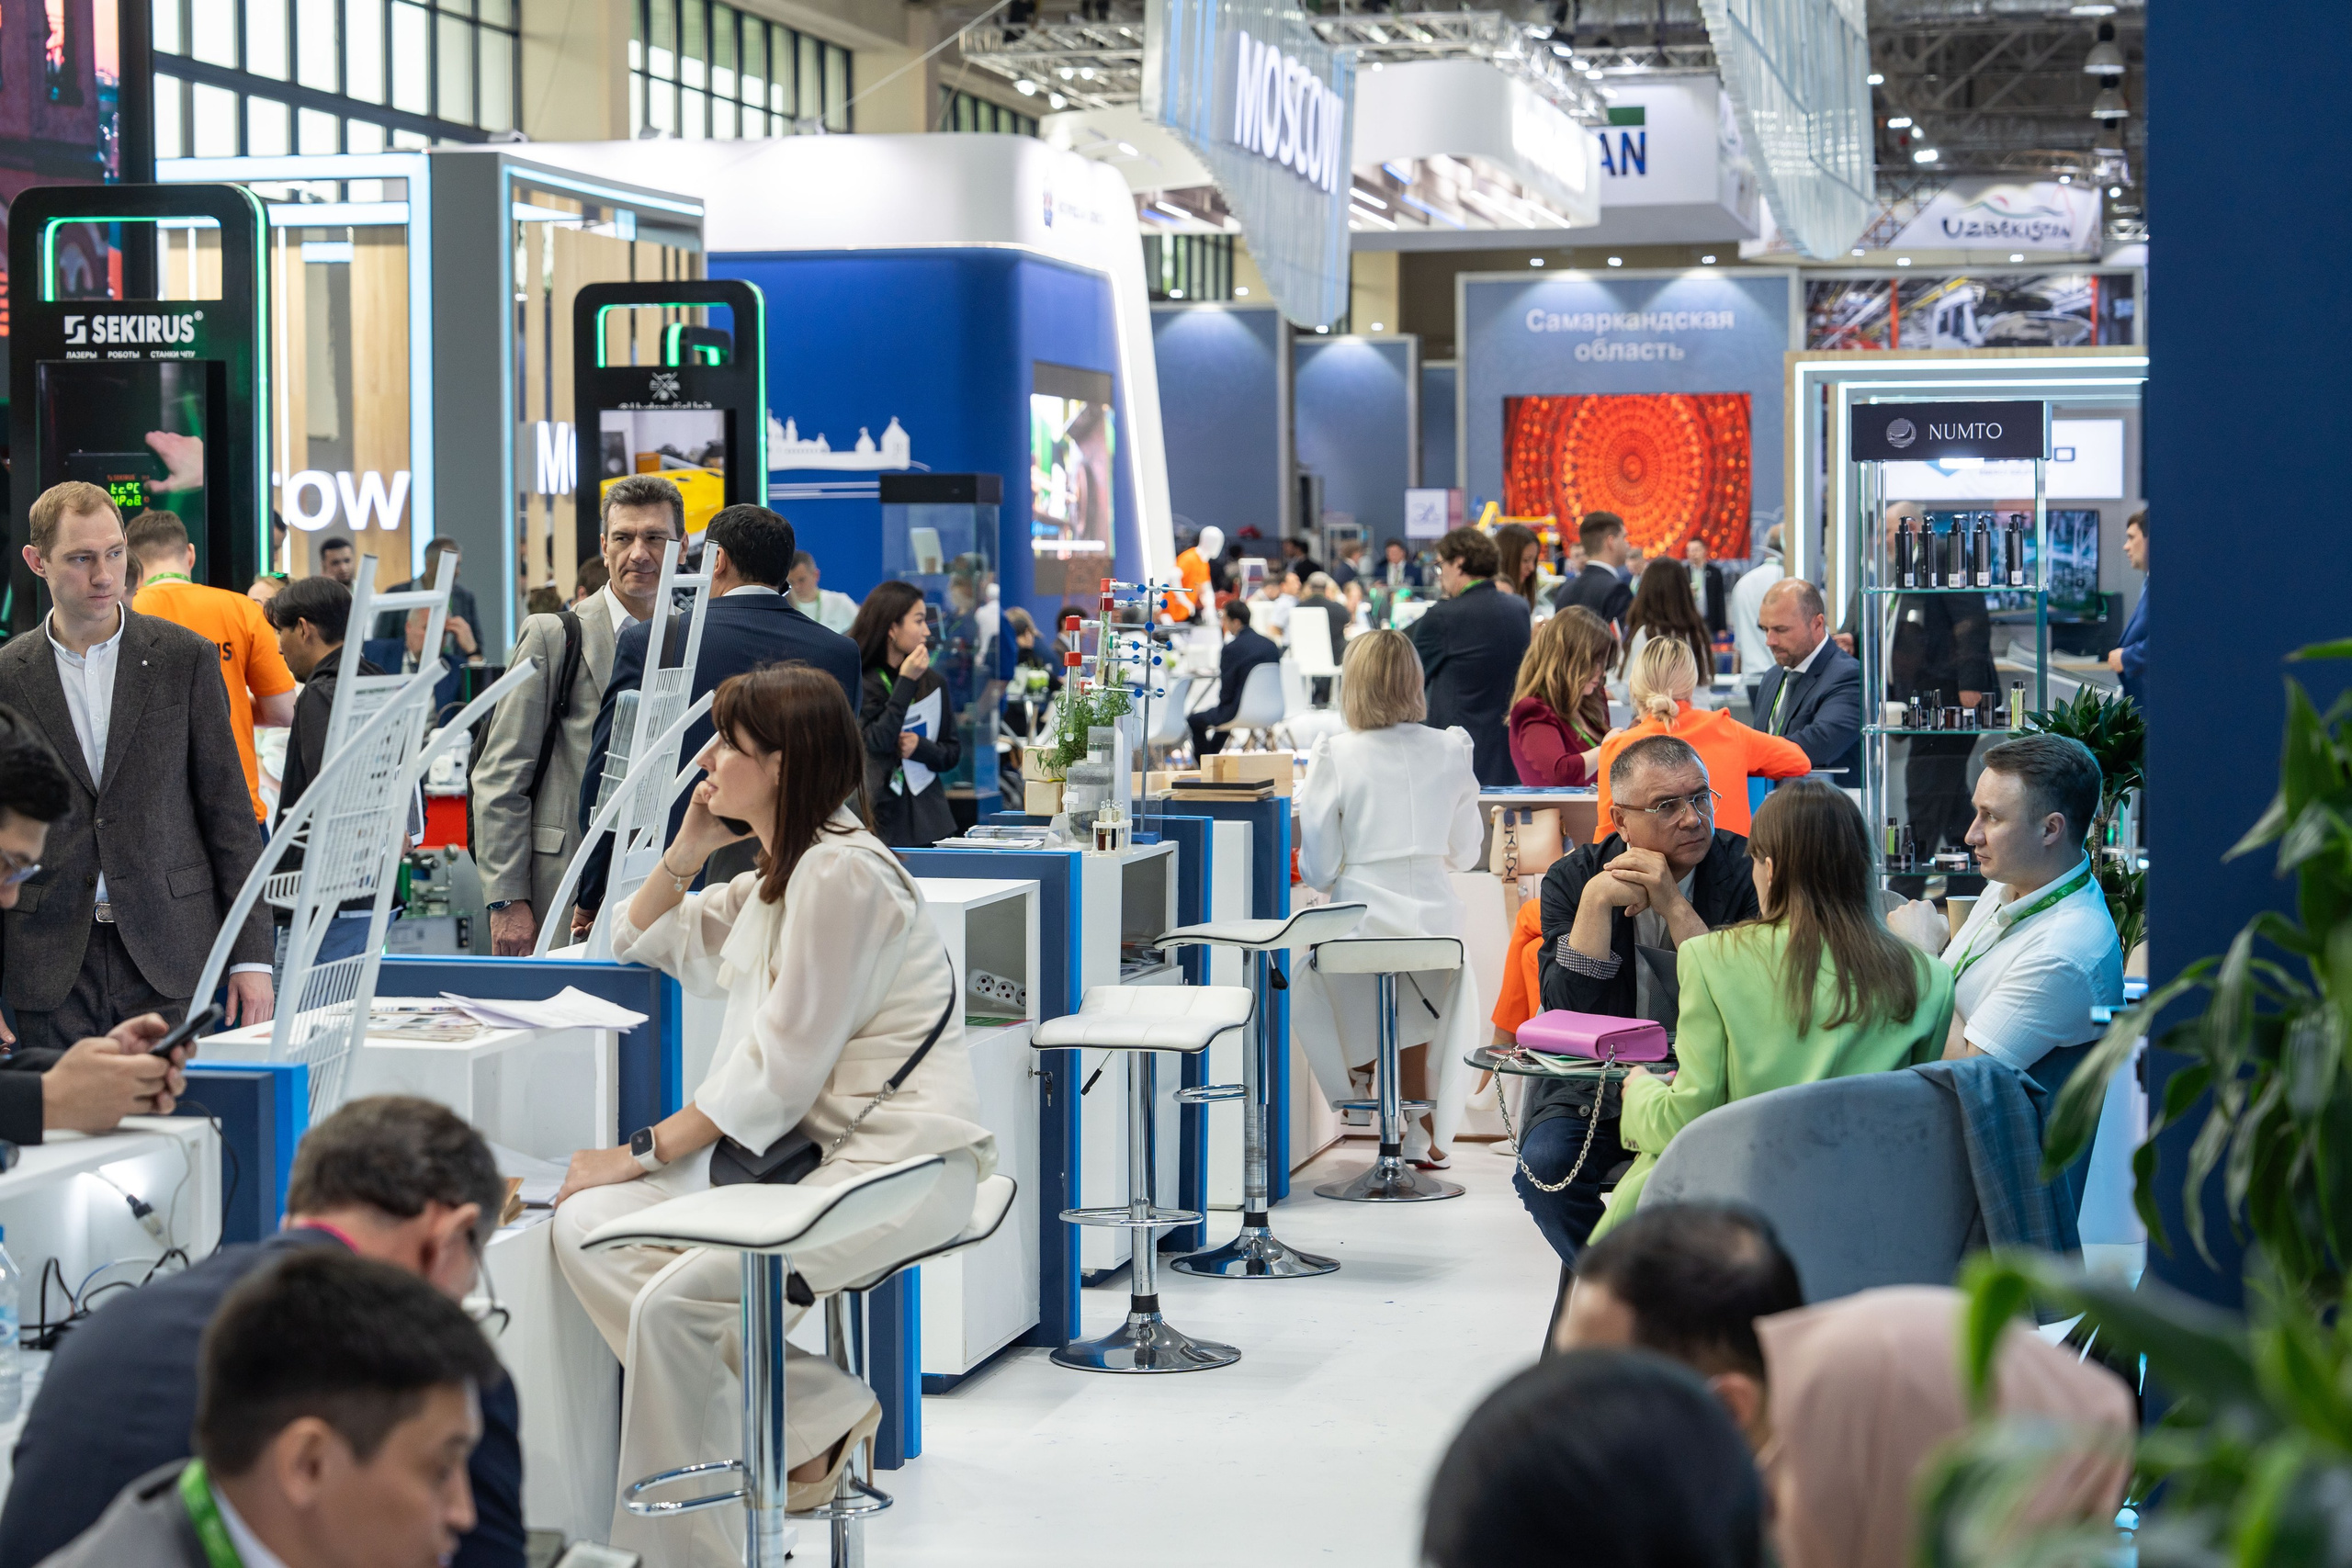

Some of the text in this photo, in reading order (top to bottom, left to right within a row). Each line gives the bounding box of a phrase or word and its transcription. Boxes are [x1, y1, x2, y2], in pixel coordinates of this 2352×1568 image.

[1234, 30, 1344, 196] MOSCOW
[1525, 308, 1735, 334] Самаркандская
[66, 350, 196, 359] ЛАЗЕРЫ РОБОТЫ СТАНКИ ЧПУ
[1574, 338, 1685, 362] область
[1929, 423, 2002, 440] NUMTO
